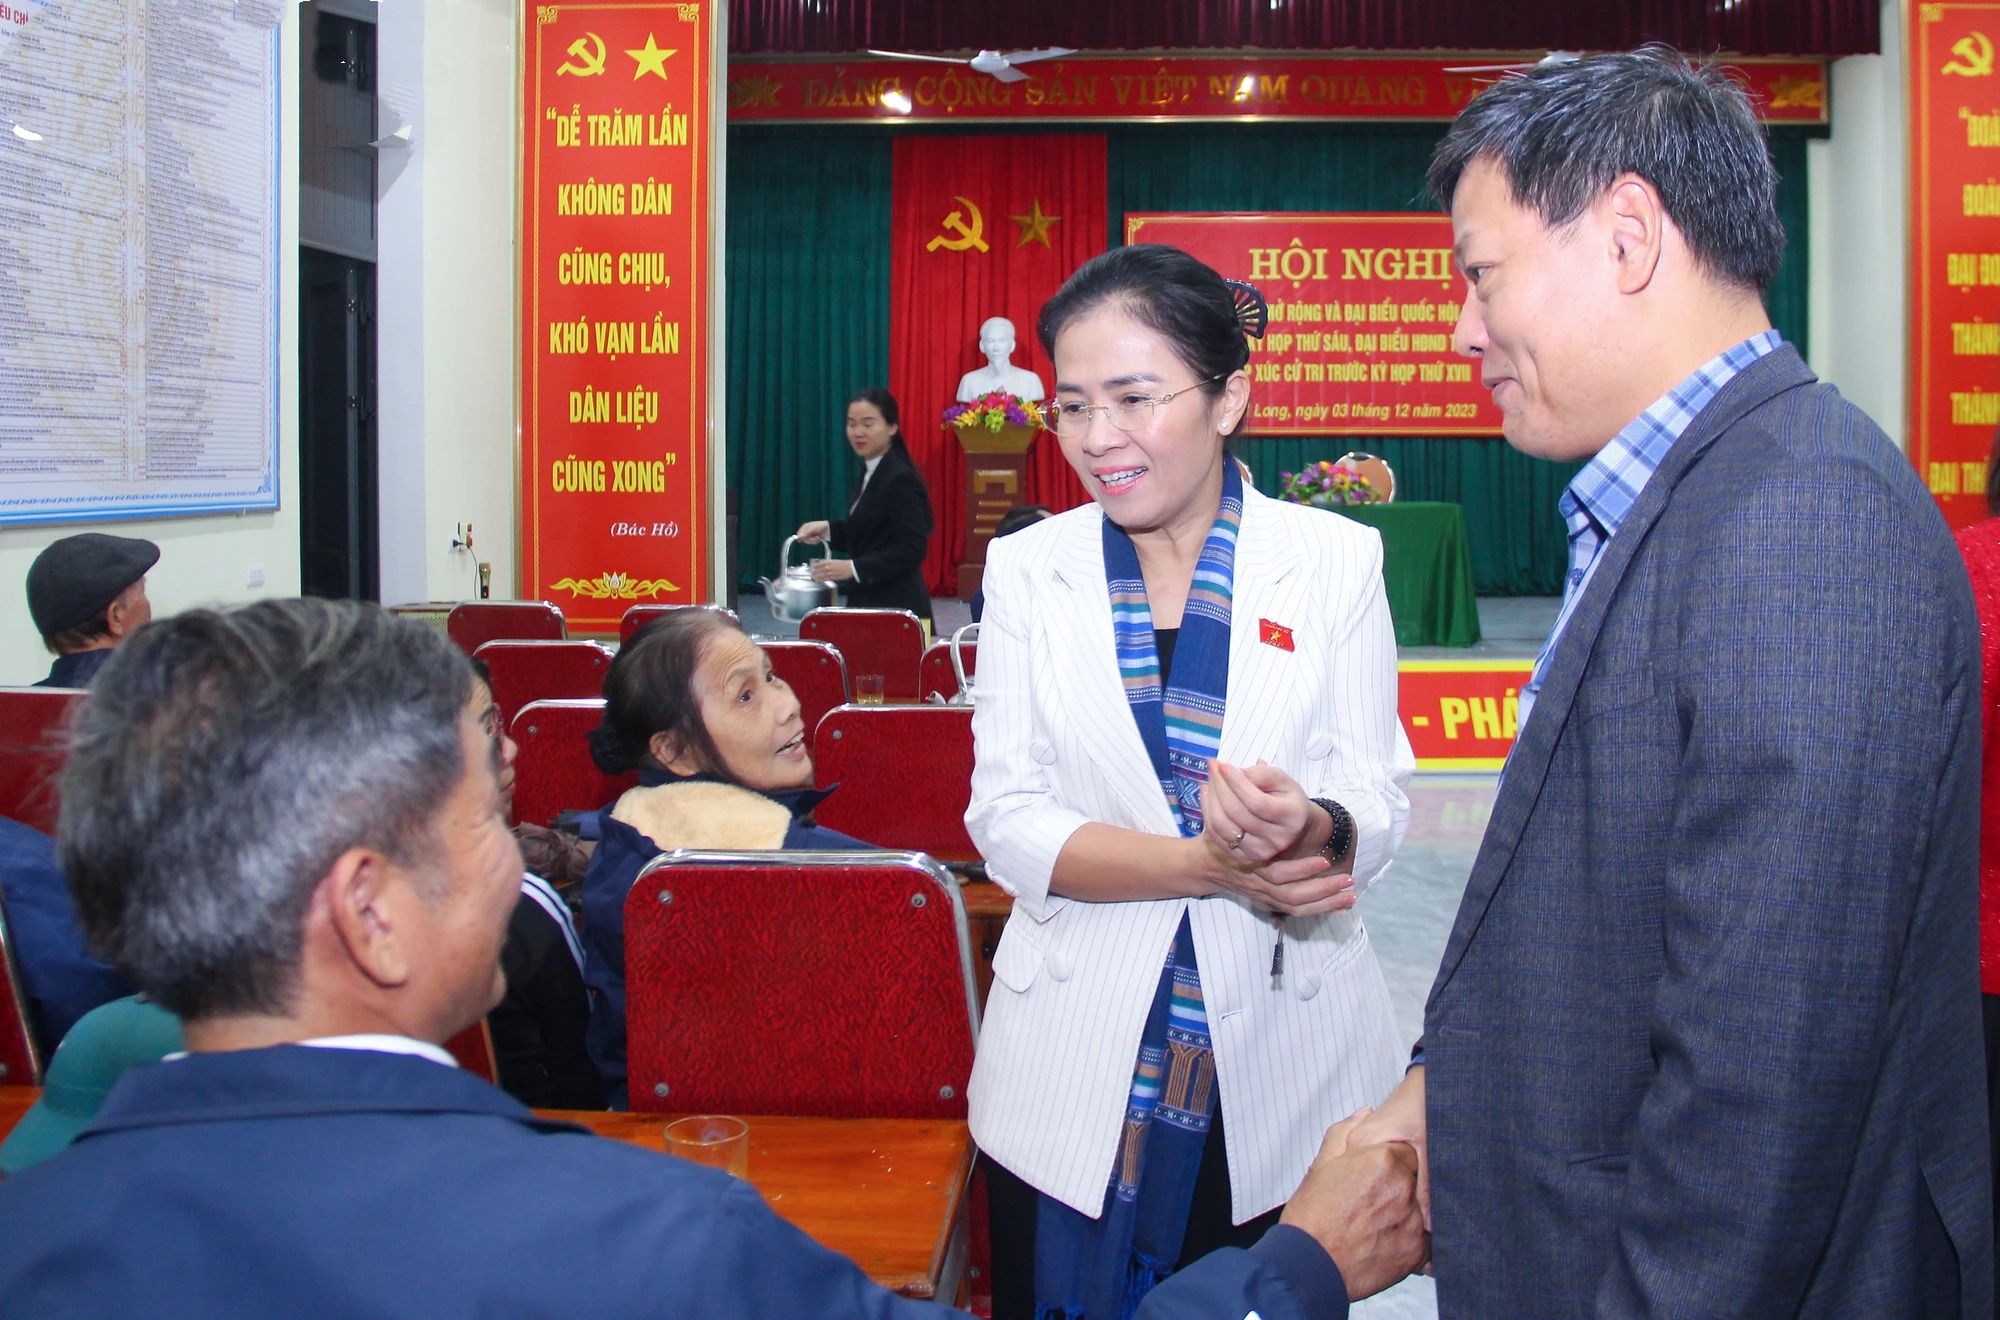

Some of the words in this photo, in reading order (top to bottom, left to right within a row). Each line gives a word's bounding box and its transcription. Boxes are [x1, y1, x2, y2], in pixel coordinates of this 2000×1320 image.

[802, 66, 903, 108] ĐẢNG
[914, 67, 1014, 113] CỘNG
[1025, 63, 1098, 106] SẢN
[1111, 66, 1197, 111] VIỆT
[1207, 74, 1290, 104] NAM
[1301, 75, 1428, 106] QUANG
[587, 107, 643, 147] TRĂM
[649, 102, 688, 146] LẦN
[558, 177, 625, 216] KHÔNG
[631, 176, 672, 216] DÂN
[1962, 177, 2000, 217] ĐOÀ
[558, 246, 612, 285] CŨNG
[618, 252, 671, 291] CHỊU,
[1249, 237, 1328, 289] HỘI
[1341, 247, 1454, 290] NGHỊ
[1947, 253, 1977, 294] ĐẠI
[1287, 300, 1321, 326] RỘNG
[1324, 300, 1342, 322] VÀ
[1344, 303, 1366, 326] ĐẠI
[1368, 297, 1398, 322] BIỂU
[1401, 298, 1435, 324] QUỐC
[1437, 300, 1460, 326] HỘI
[550, 315, 589, 354] KHÓ
[595, 321, 635, 361] VẠN
[640, 311, 679, 354] LẦN
[1267, 333, 1293, 356] HỌP
[1295, 330, 1321, 352] THỨ
[1323, 330, 1352, 353] SÁU,
[1355, 333, 1377, 356] ĐẠI
[1379, 327, 1409, 352] BIỂU
[1412, 333, 1447, 352] HĐND
[1951, 316, 2000, 356] THÀN
[1255, 360, 1280, 382] XÚC
[1284, 358, 1303, 382] CỬ
[1304, 364, 1324, 382] TRI
[1327, 360, 1368, 382] TRƯỚC
[1390, 363, 1416, 386] HỌP
[1418, 360, 1445, 382] THỨ
[569, 384, 610, 424] DÂN
[616, 384, 658, 430] LIỆU
[1253, 403, 1292, 421] Long,
[1295, 402, 1329, 421] ngày
[1332, 403, 1348, 418] 03
[1352, 402, 1390, 421] tháng
[1394, 403, 1410, 418] 12
[1412, 403, 1442, 418] năm
[1445, 403, 1478, 418] 2023
[1950, 385, 2000, 426] THÀN
[552, 454, 606, 493] CŨNG
[612, 452, 676, 493] XONG”
[610, 522, 646, 538] (Bác
[650, 521, 679, 538] Hồ)
[1440, 687, 1520, 739] PHÁ
